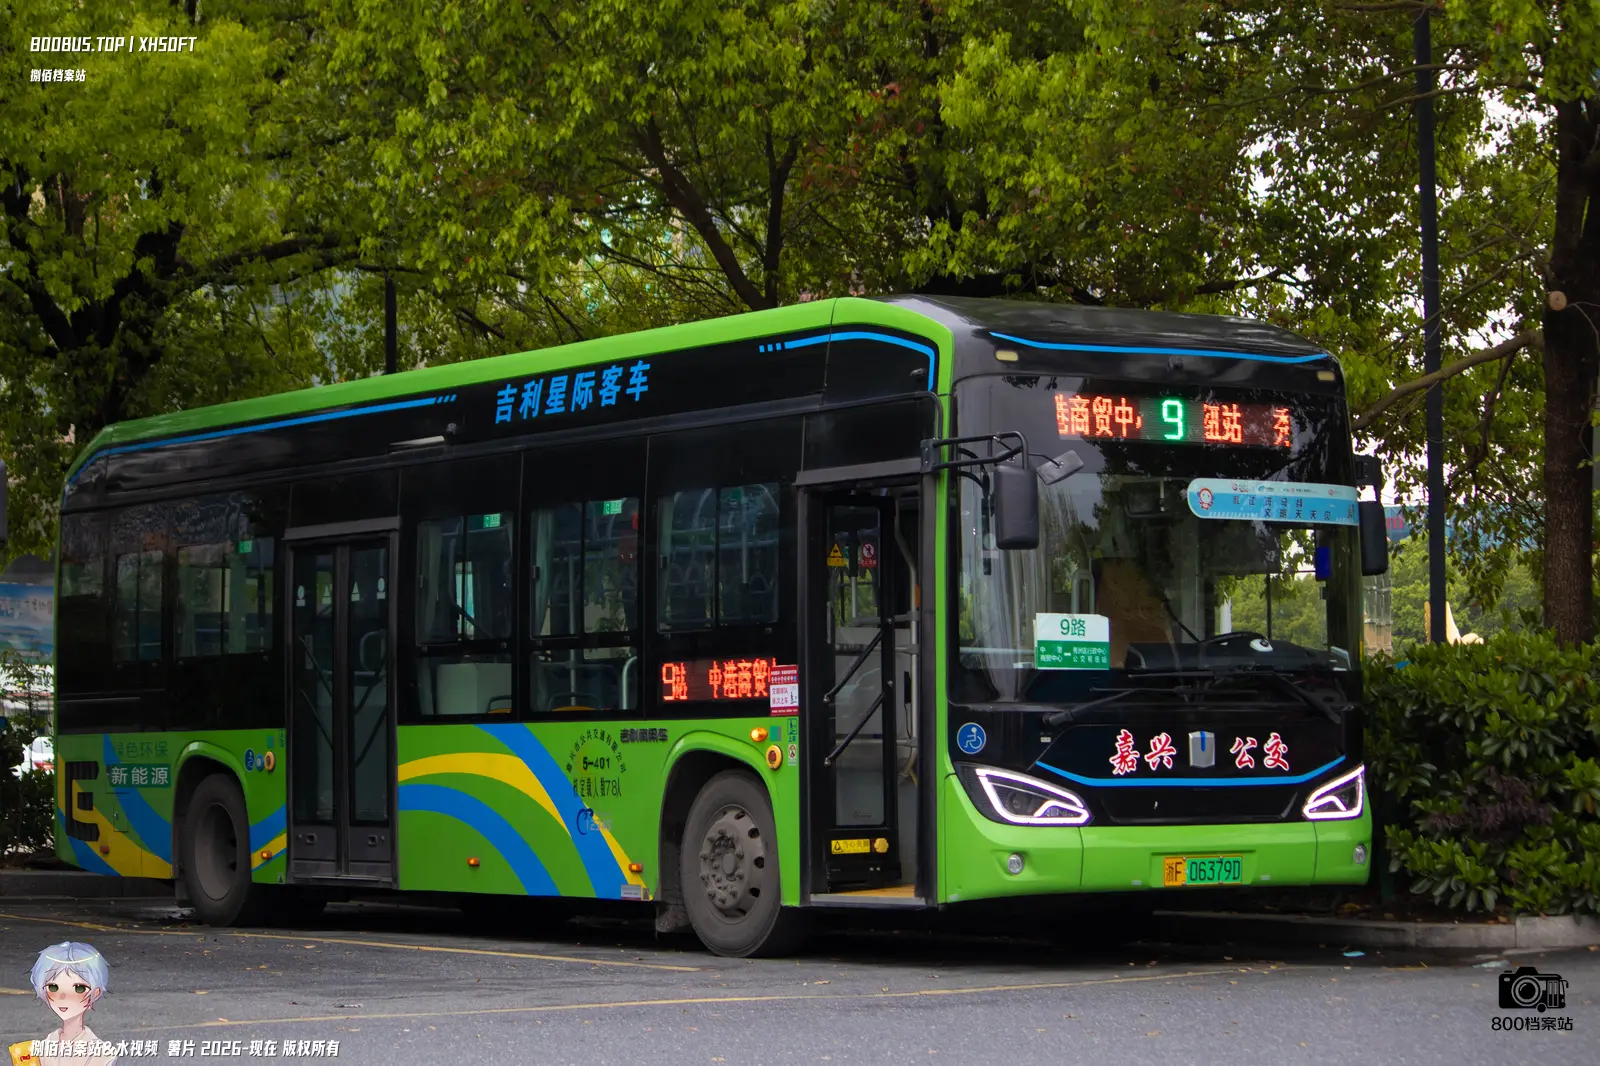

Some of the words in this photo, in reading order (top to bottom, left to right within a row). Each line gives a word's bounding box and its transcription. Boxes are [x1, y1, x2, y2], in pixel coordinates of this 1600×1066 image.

[495, 360, 650, 424] 吉利星际客车
[1161, 399, 1184, 440] 9
[1060, 618, 1087, 637] 9路
[582, 756, 610, 771] 5-401
[1109, 729, 1177, 776] 嘉兴
[1229, 732, 1290, 772] 公交
[111, 766, 169, 785] 新能源
[1189, 859, 1241, 882] 06379D
